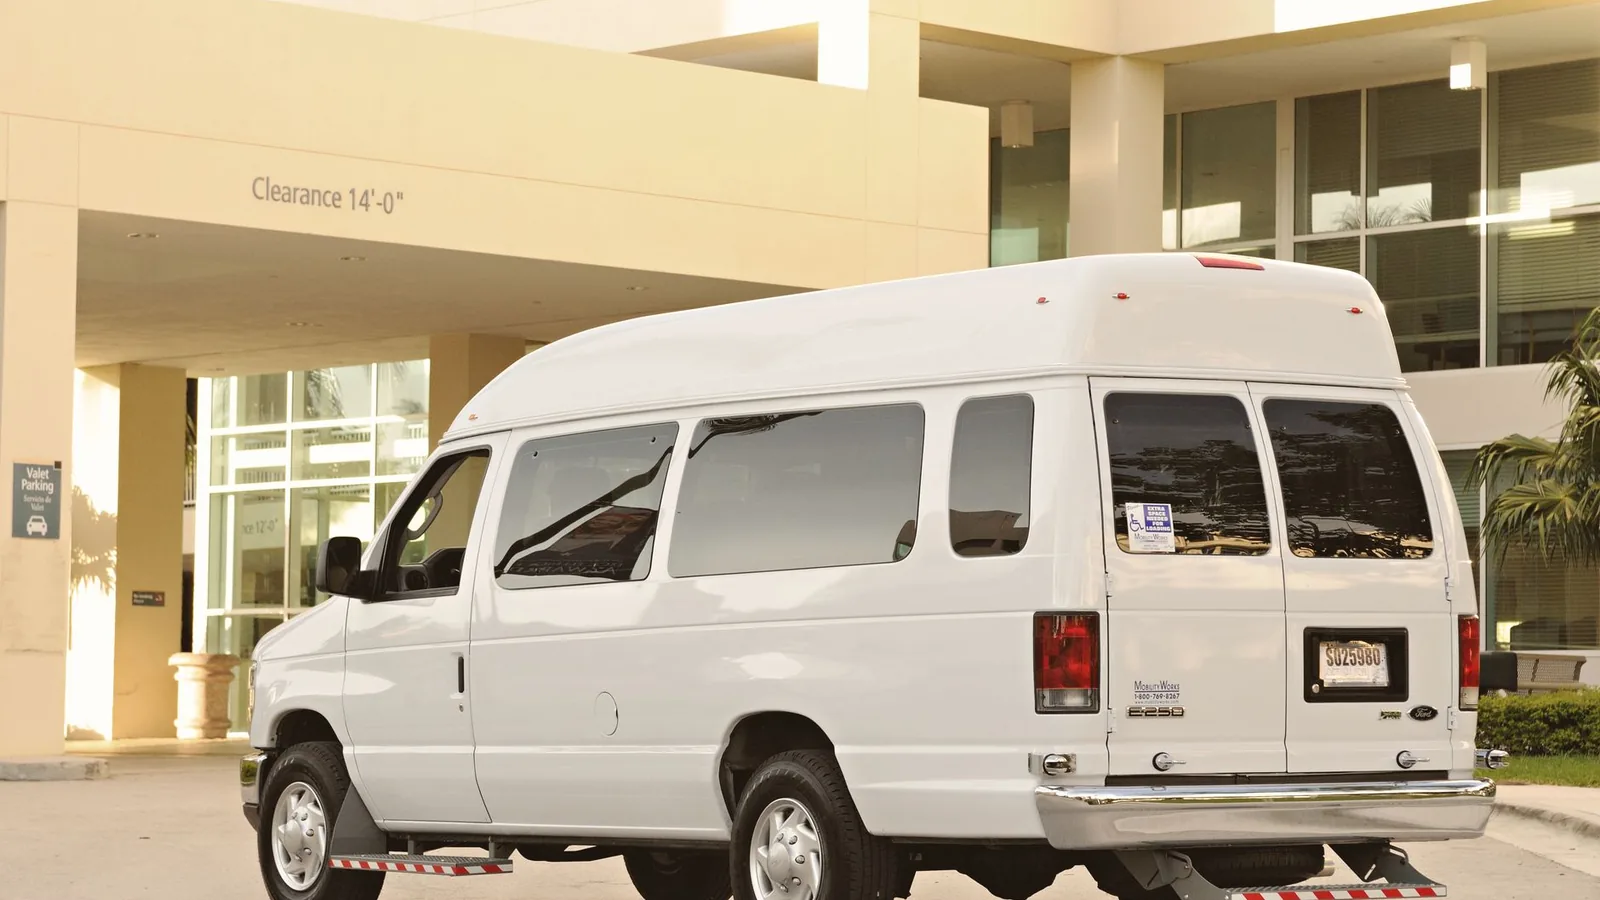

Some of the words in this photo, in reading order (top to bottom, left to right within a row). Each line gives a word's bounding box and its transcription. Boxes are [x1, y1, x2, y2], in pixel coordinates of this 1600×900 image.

[252, 176, 342, 209] Clearance
[349, 188, 404, 214] 14'-0"
[26, 467, 49, 480] Valet
[21, 478, 54, 495] Parking
[1414, 707, 1433, 718] Ford
